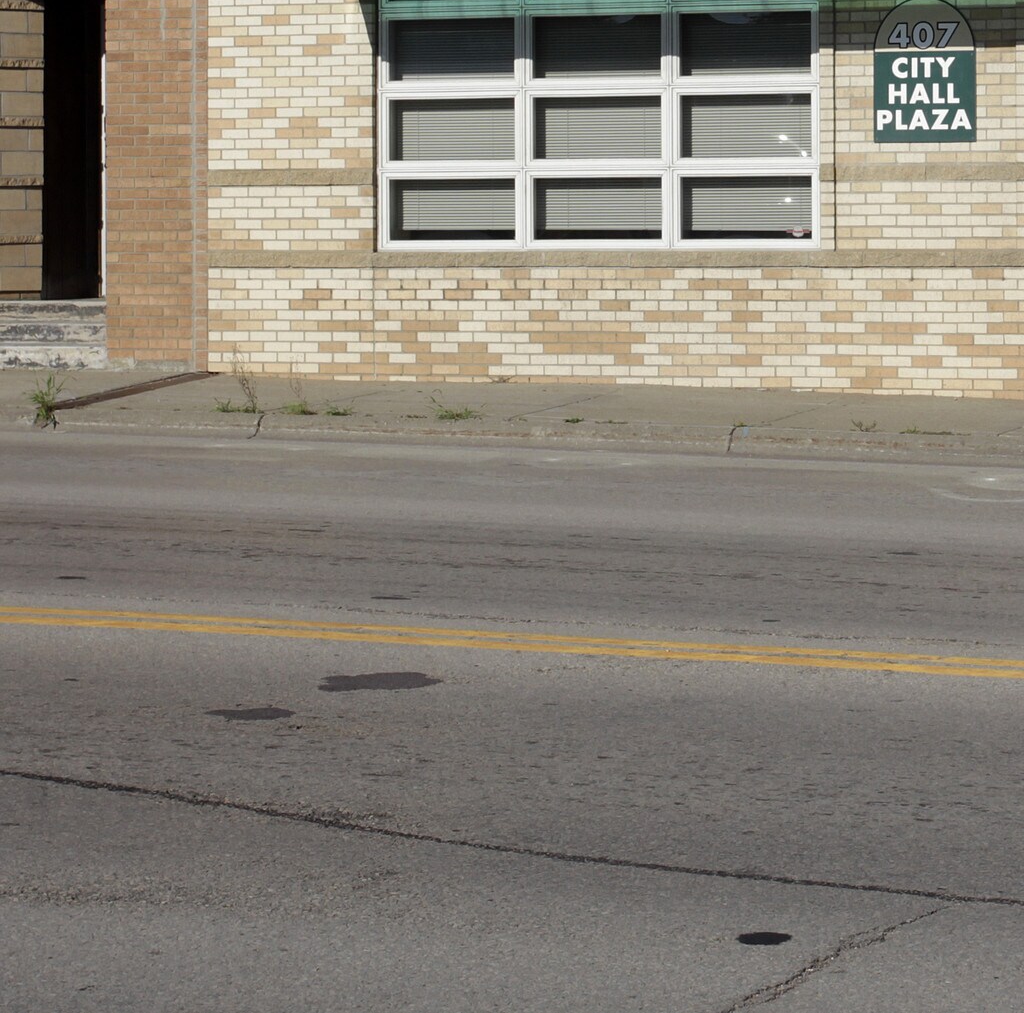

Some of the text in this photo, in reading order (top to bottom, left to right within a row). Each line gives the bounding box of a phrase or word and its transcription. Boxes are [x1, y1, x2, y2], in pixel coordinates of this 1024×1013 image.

[888, 21, 960, 50] 407
[892, 57, 956, 79] CITY
[888, 83, 960, 105] HALL
[876, 109, 972, 131] PLAZA
